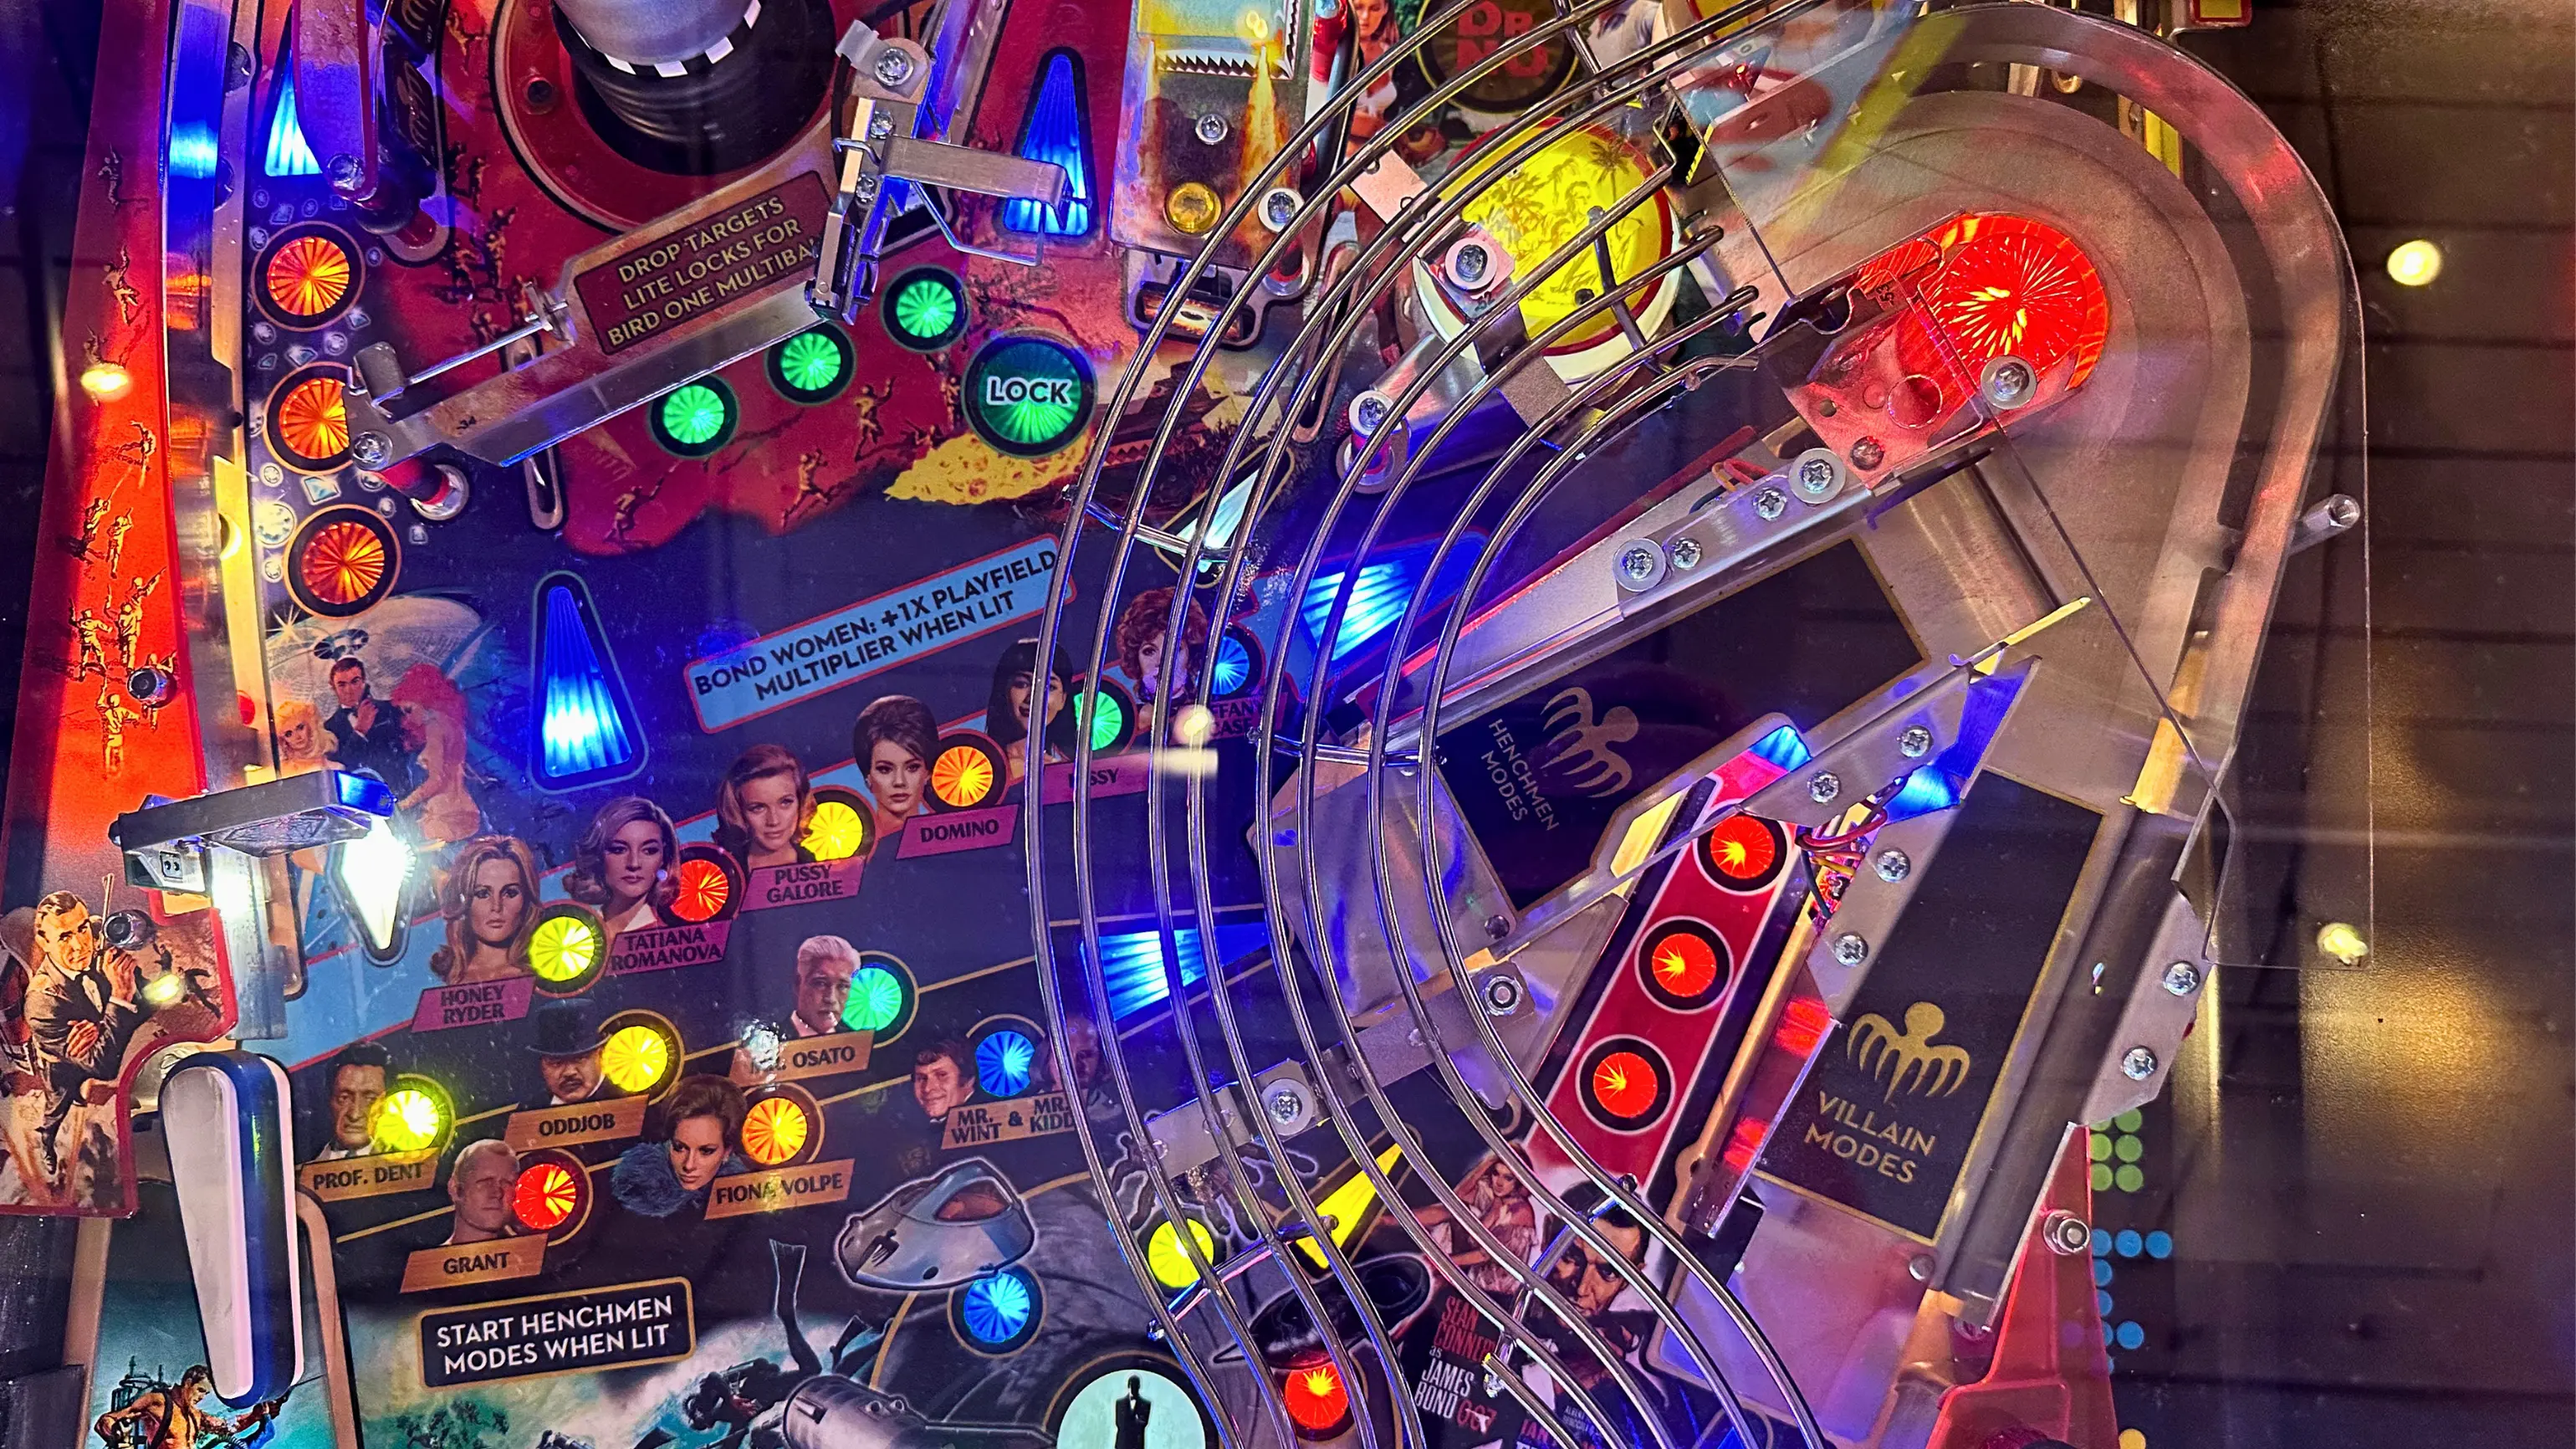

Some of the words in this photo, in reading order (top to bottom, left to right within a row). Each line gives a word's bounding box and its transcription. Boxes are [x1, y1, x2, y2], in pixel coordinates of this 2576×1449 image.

[619, 243, 681, 283] DROP
[684, 197, 785, 252] TARGETS
[623, 277, 673, 310] LITE
[676, 240, 752, 285] LOCKS
[754, 218, 801, 251] FOR
[607, 312, 661, 346] BIRD
[665, 286, 714, 320] ONE
[717, 239, 816, 297] MULTIBA
[989, 378, 1071, 406] LOCK
[694, 655, 767, 696] BOND
[770, 617, 877, 666] WOMEN:
[881, 595, 931, 627] +1X
[932, 550, 1057, 610] PLAYFIELD
[754, 635, 897, 701] MULTIPLIER
[898, 605, 977, 647] WHEN
[979, 590, 1014, 620] LIT
[1480, 750, 1529, 821] MODES
[1489, 718, 1560, 832] HENCHMEN
[920, 818, 999, 843] DOMINO
[774, 863, 833, 886] PUSSY
[766, 880, 843, 904] GALORE
[624, 927, 707, 952] TATIANA
[611, 945, 723, 972] ROMANOVA
[440, 983, 506, 1006] HONEY
[443, 1004, 506, 1025] RYDER
[792, 1045, 856, 1068] OSATO
[538, 1113, 616, 1137] ODDJOB
[951, 1123, 1003, 1144] WINT
[1008, 1110, 1024, 1127] &
[957, 1108, 994, 1127] MR.
[1034, 1096, 1069, 1115] MR.
[1819, 1089, 1936, 1157] VILLAIN
[1803, 1122, 1918, 1184] MODES
[313, 1169, 368, 1190] PROF.
[374, 1162, 424, 1183] DENT
[716, 1180, 776, 1205] FIONA
[780, 1173, 844, 1196] VOLPE
[443, 1252, 510, 1275] GRANT
[437, 1317, 514, 1348] START
[521, 1294, 673, 1336] HENCHMEN
[1441, 1296, 1480, 1333] SEAN
[444, 1343, 539, 1375] MODES
[544, 1331, 625, 1360] WHEN
[631, 1324, 669, 1349] LIT
[1429, 1345, 1443, 1359] as
[1422, 1357, 1475, 1398] JAMES
[1413, 1380, 1459, 1420] BOND
